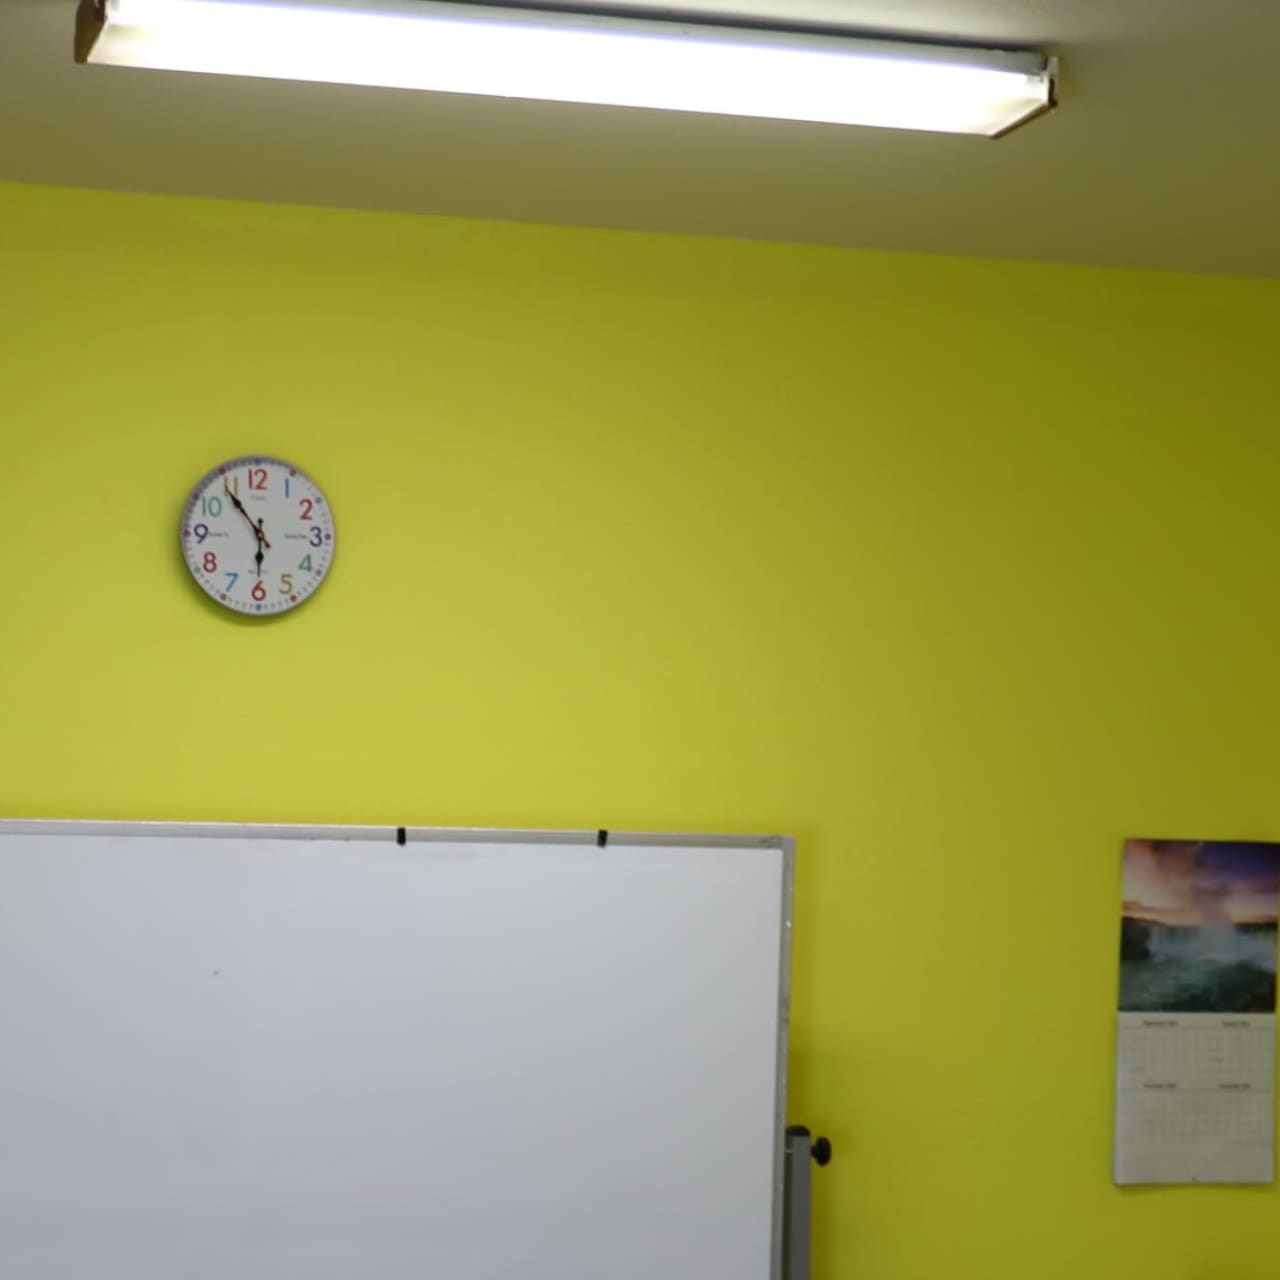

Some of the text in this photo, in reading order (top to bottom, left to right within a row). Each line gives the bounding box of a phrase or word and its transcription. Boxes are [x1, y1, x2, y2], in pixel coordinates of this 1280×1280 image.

[248, 468, 268, 490] 12
[202, 496, 222, 517] 10
[299, 498, 313, 520] 2
[193, 523, 209, 544] 9
[309, 526, 323, 548] 3
[202, 552, 217, 573] 8
[298, 554, 313, 572] 4
[224, 572, 239, 592] 7
[251, 580, 267, 601] 6
[279, 573, 293, 594] 5
